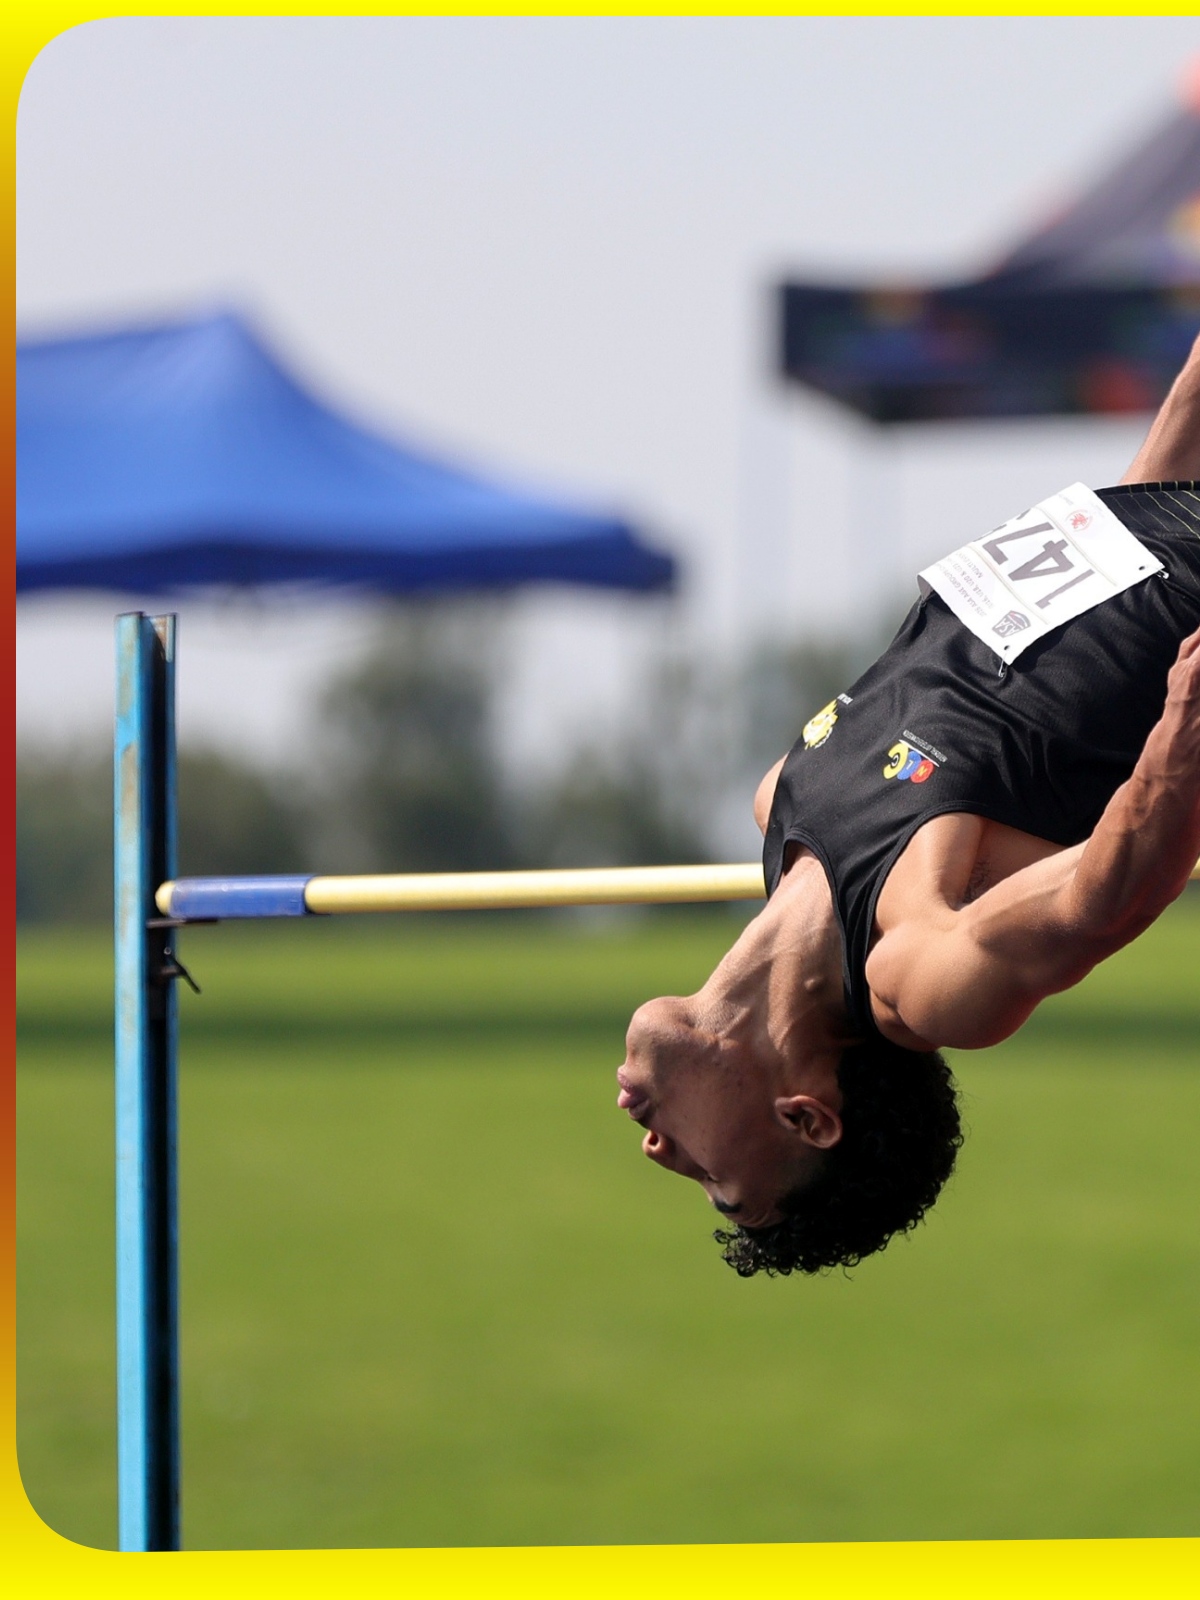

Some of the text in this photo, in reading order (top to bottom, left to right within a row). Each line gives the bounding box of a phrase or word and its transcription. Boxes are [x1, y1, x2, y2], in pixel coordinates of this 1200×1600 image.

[972, 507, 1095, 609] 147
[963, 574, 975, 587] U20
[957, 586, 970, 599] AGE
[966, 596, 977, 608] ASA
[994, 617, 1019, 639] ASA
